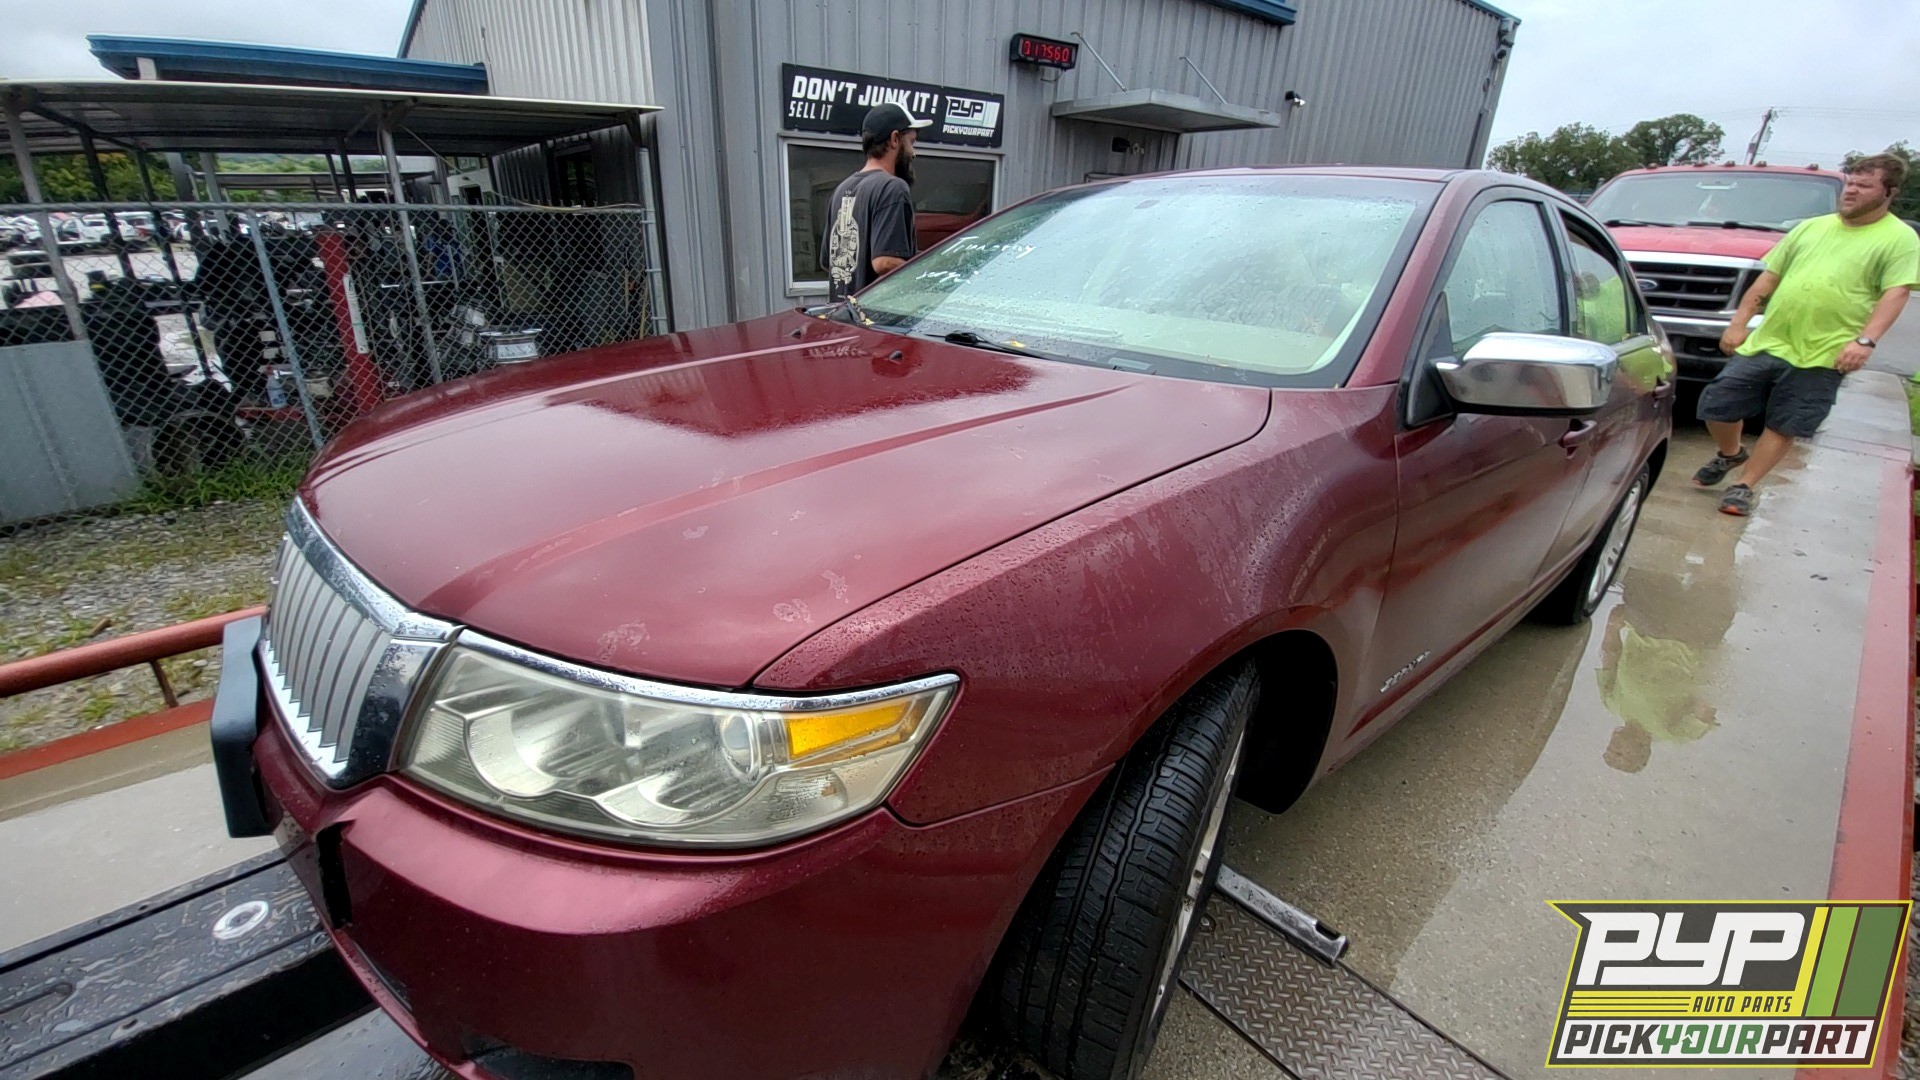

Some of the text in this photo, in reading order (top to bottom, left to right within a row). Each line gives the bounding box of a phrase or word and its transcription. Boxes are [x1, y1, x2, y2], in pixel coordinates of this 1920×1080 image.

[792, 75, 857, 104] DON'T
[858, 85, 911, 111] JUNK
[788, 100, 833, 120] SELL IT
[948, 98, 984, 118] PYP
